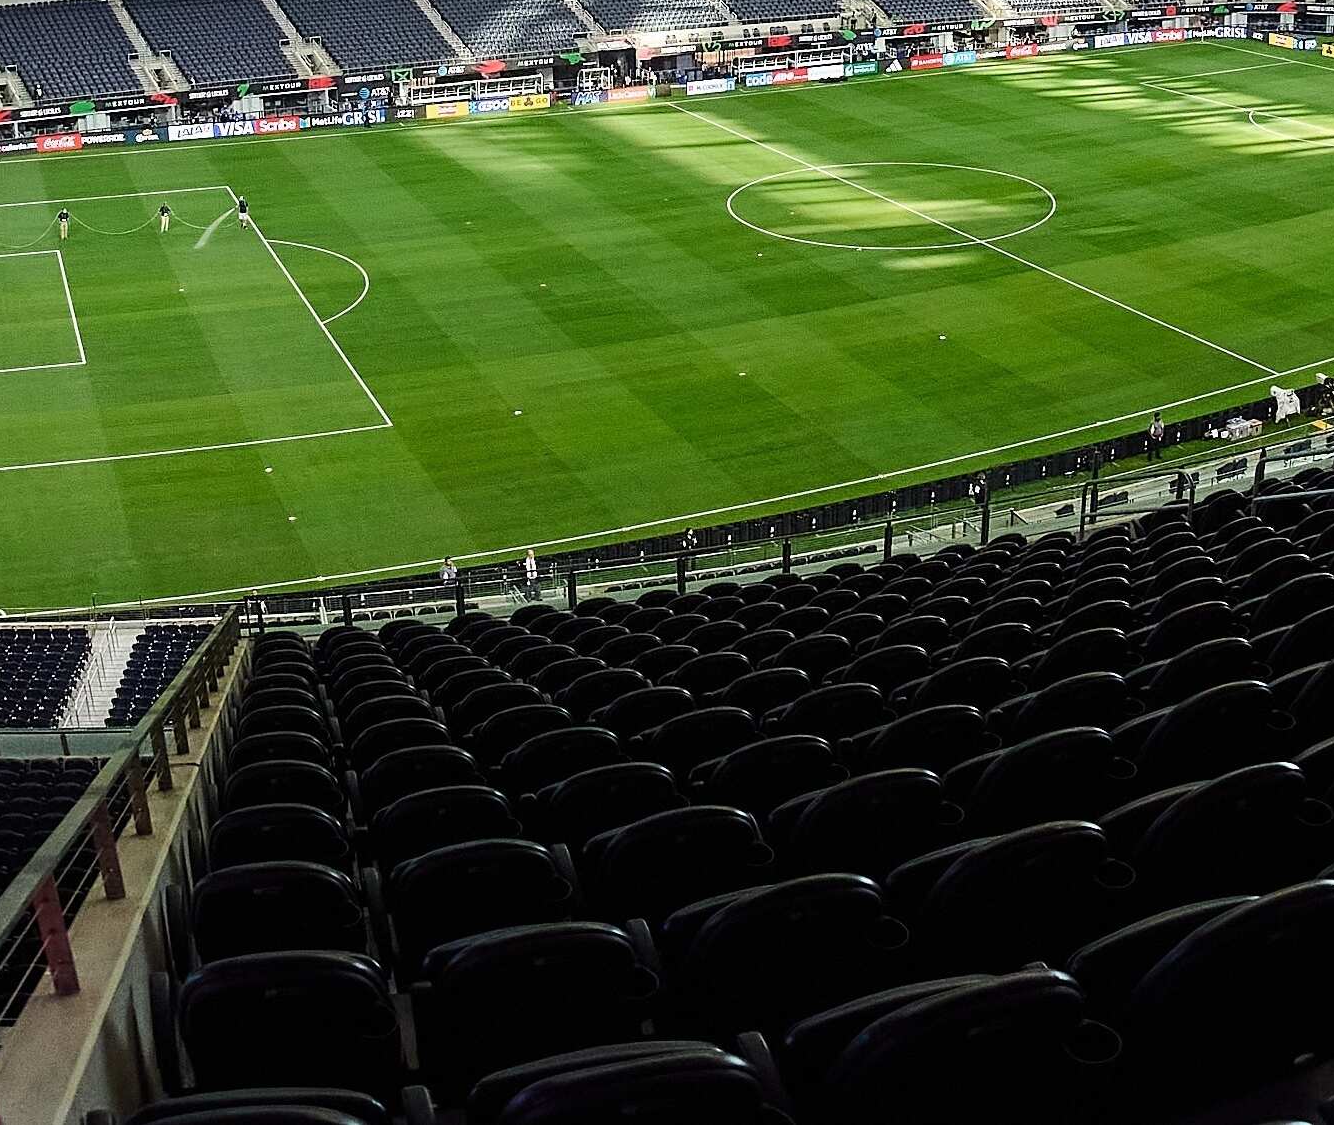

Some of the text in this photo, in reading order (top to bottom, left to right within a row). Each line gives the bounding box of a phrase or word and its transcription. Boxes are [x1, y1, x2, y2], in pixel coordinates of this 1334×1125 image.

[1253, 3, 1269, 11] AT&T
[881, 27, 898, 36] AT&T
[1155, 30, 1184, 41] Scribe
[1127, 31, 1153, 44] VISA
[955, 53, 974, 64] AT&T
[447, 65, 466, 75] AT&T
[371, 86, 391, 97] AT&T
[259, 118, 297, 133] Scribe
[311, 115, 343, 127] MetLife
[220, 120, 255, 137] VISA
